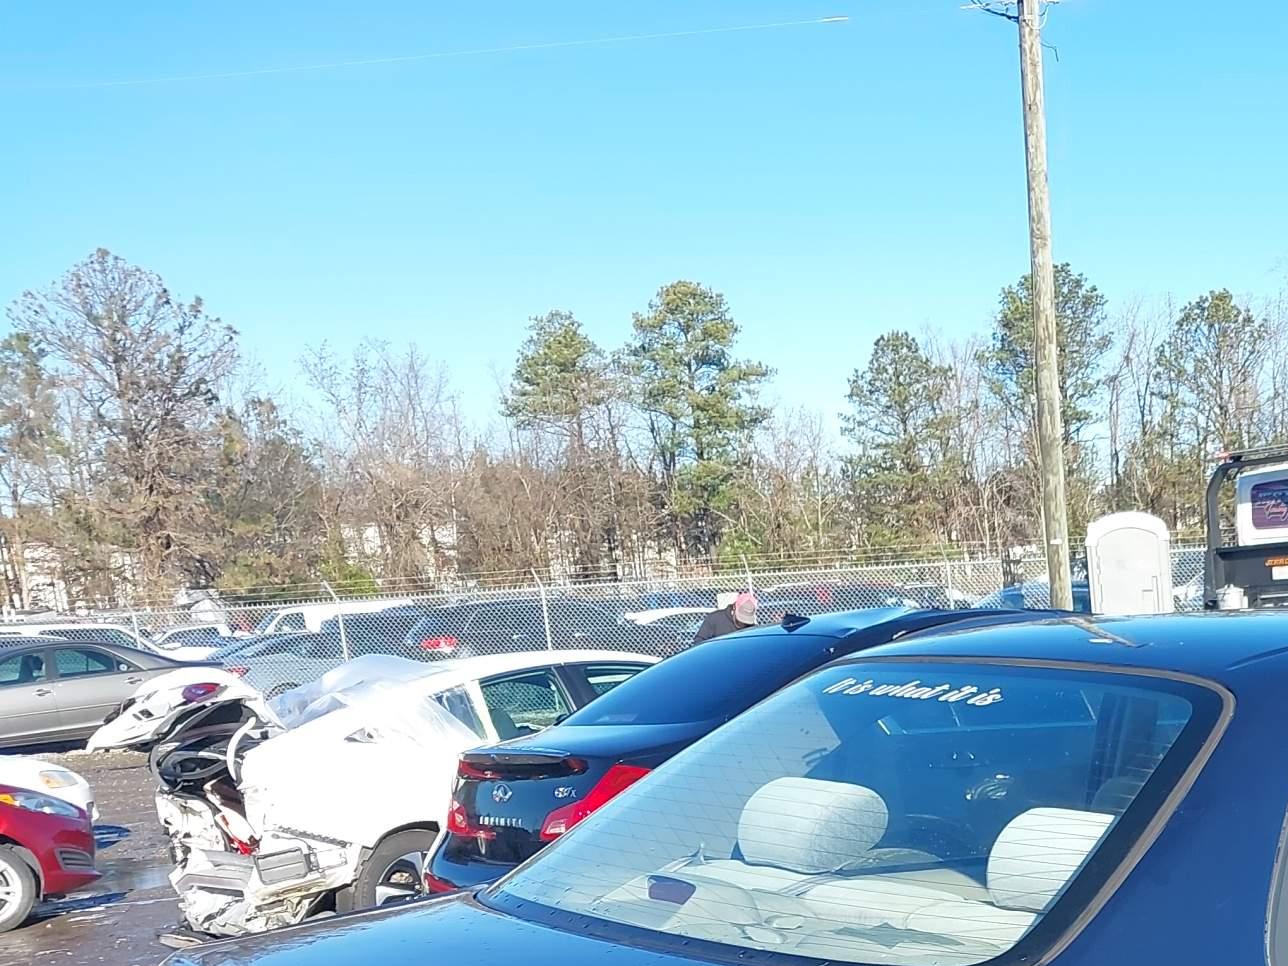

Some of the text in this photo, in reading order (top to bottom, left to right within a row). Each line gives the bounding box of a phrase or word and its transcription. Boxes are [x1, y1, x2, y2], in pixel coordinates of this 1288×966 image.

[822, 676, 1005, 706] It is what it is
